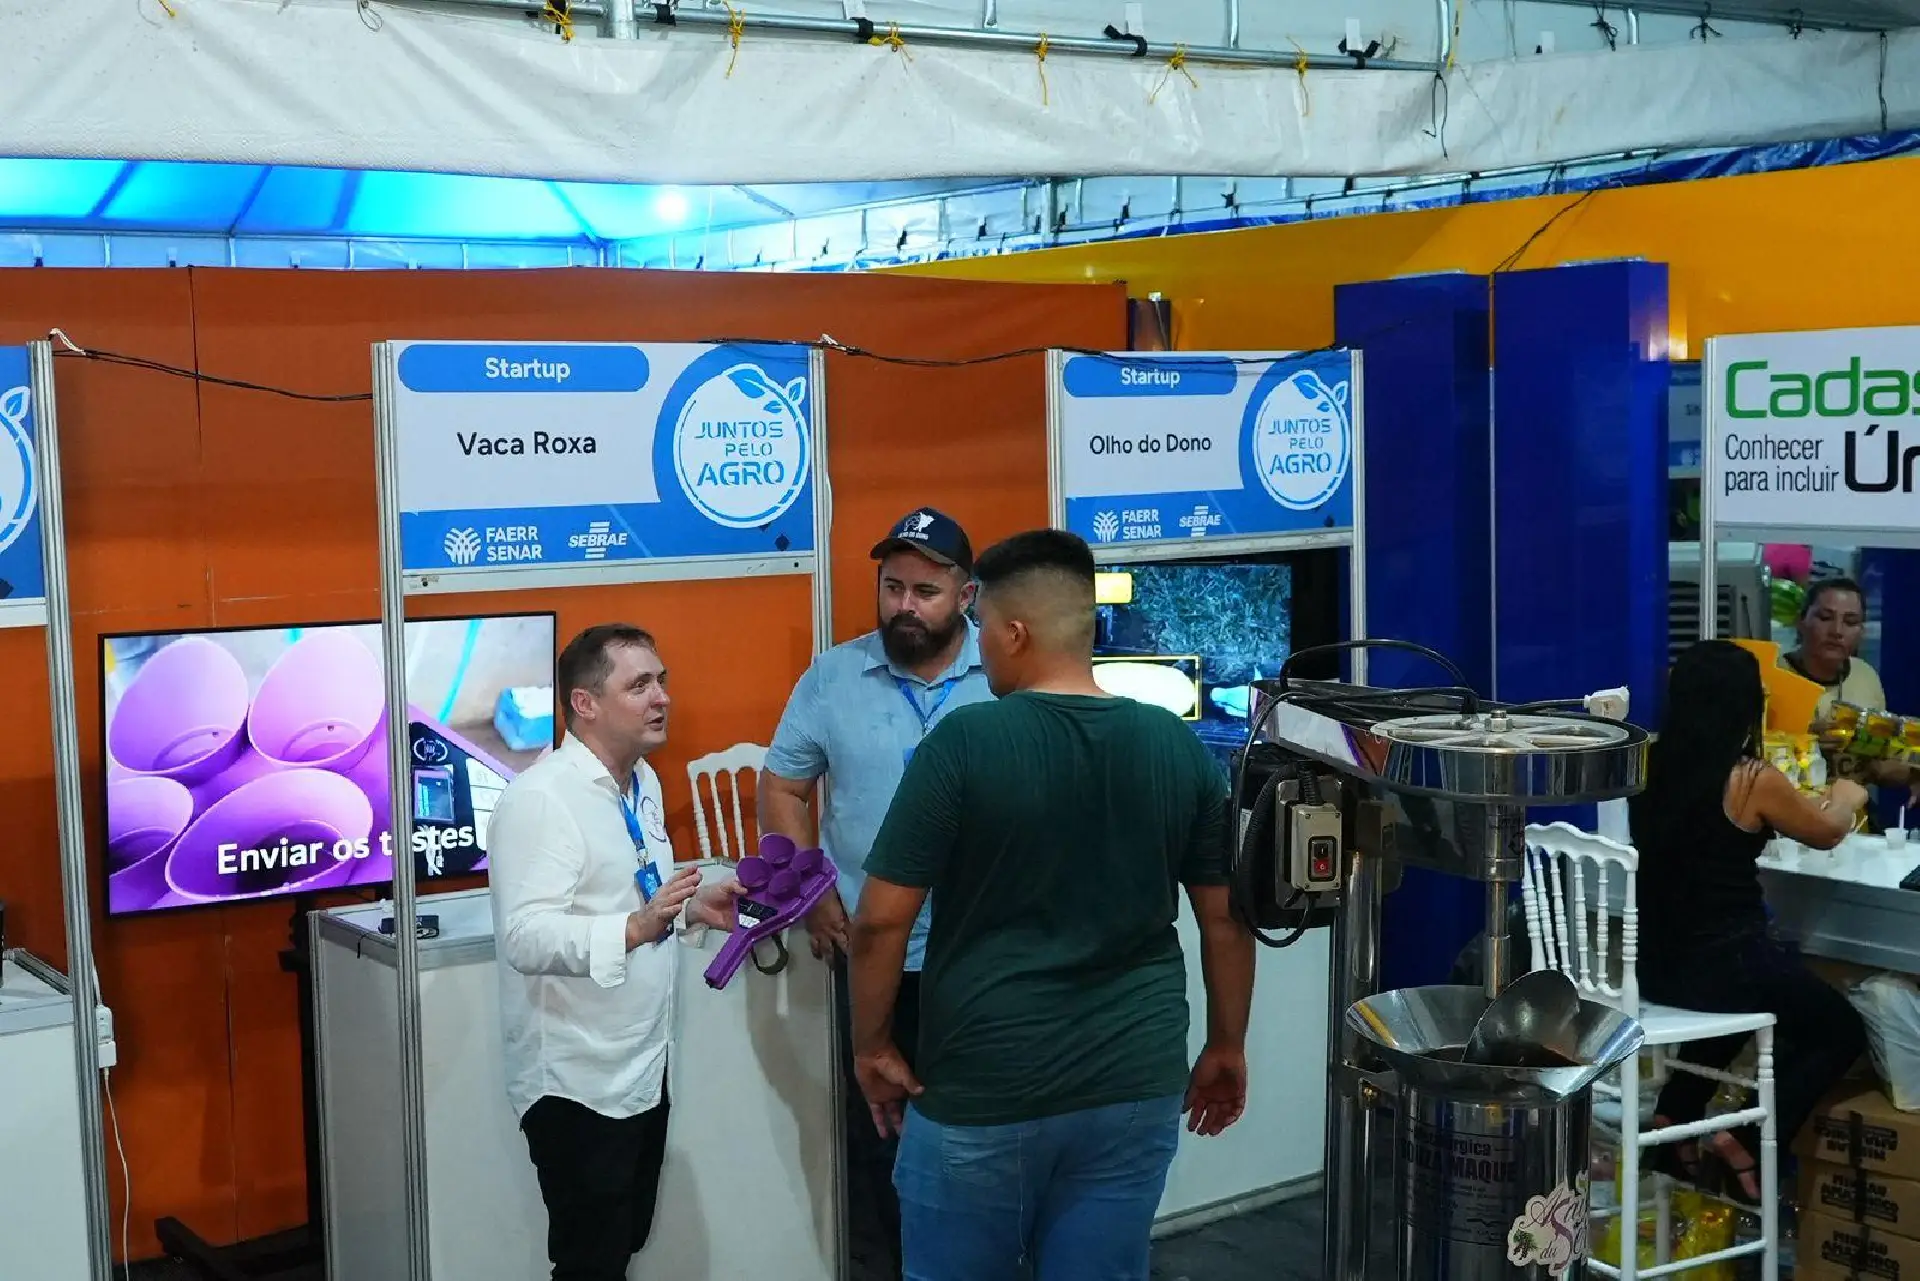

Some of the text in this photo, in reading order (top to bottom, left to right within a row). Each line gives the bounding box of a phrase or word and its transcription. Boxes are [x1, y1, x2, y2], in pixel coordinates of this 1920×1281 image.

[485, 357, 571, 383] Startup
[1121, 368, 1180, 387] Startup
[694, 421, 784, 439] JUNTOS
[1268, 418, 1332, 435] JUNTOS
[456, 430, 597, 456] Vaca Roxa
[725, 442, 773, 457] PELO
[1090, 434, 1212, 455] Olho do Dono
[1289, 437, 1324, 450] PELO
[1725, 434, 1824, 460] Conhecer
[1269, 453, 1332, 475] AGRO
[697, 461, 785, 486] AGRO
[1725, 465, 1839, 496] para incluir
[1122, 510, 1159, 523] FAERR
[1179, 514, 1221, 527] SEBRAE
[486, 526, 538, 542] FAERR
[568, 532, 627, 547] SEBRAE
[1123, 525, 1162, 539] SENAR
[486, 543, 542, 561] SENAR
[217, 825, 475, 875] Enviar os tstes
